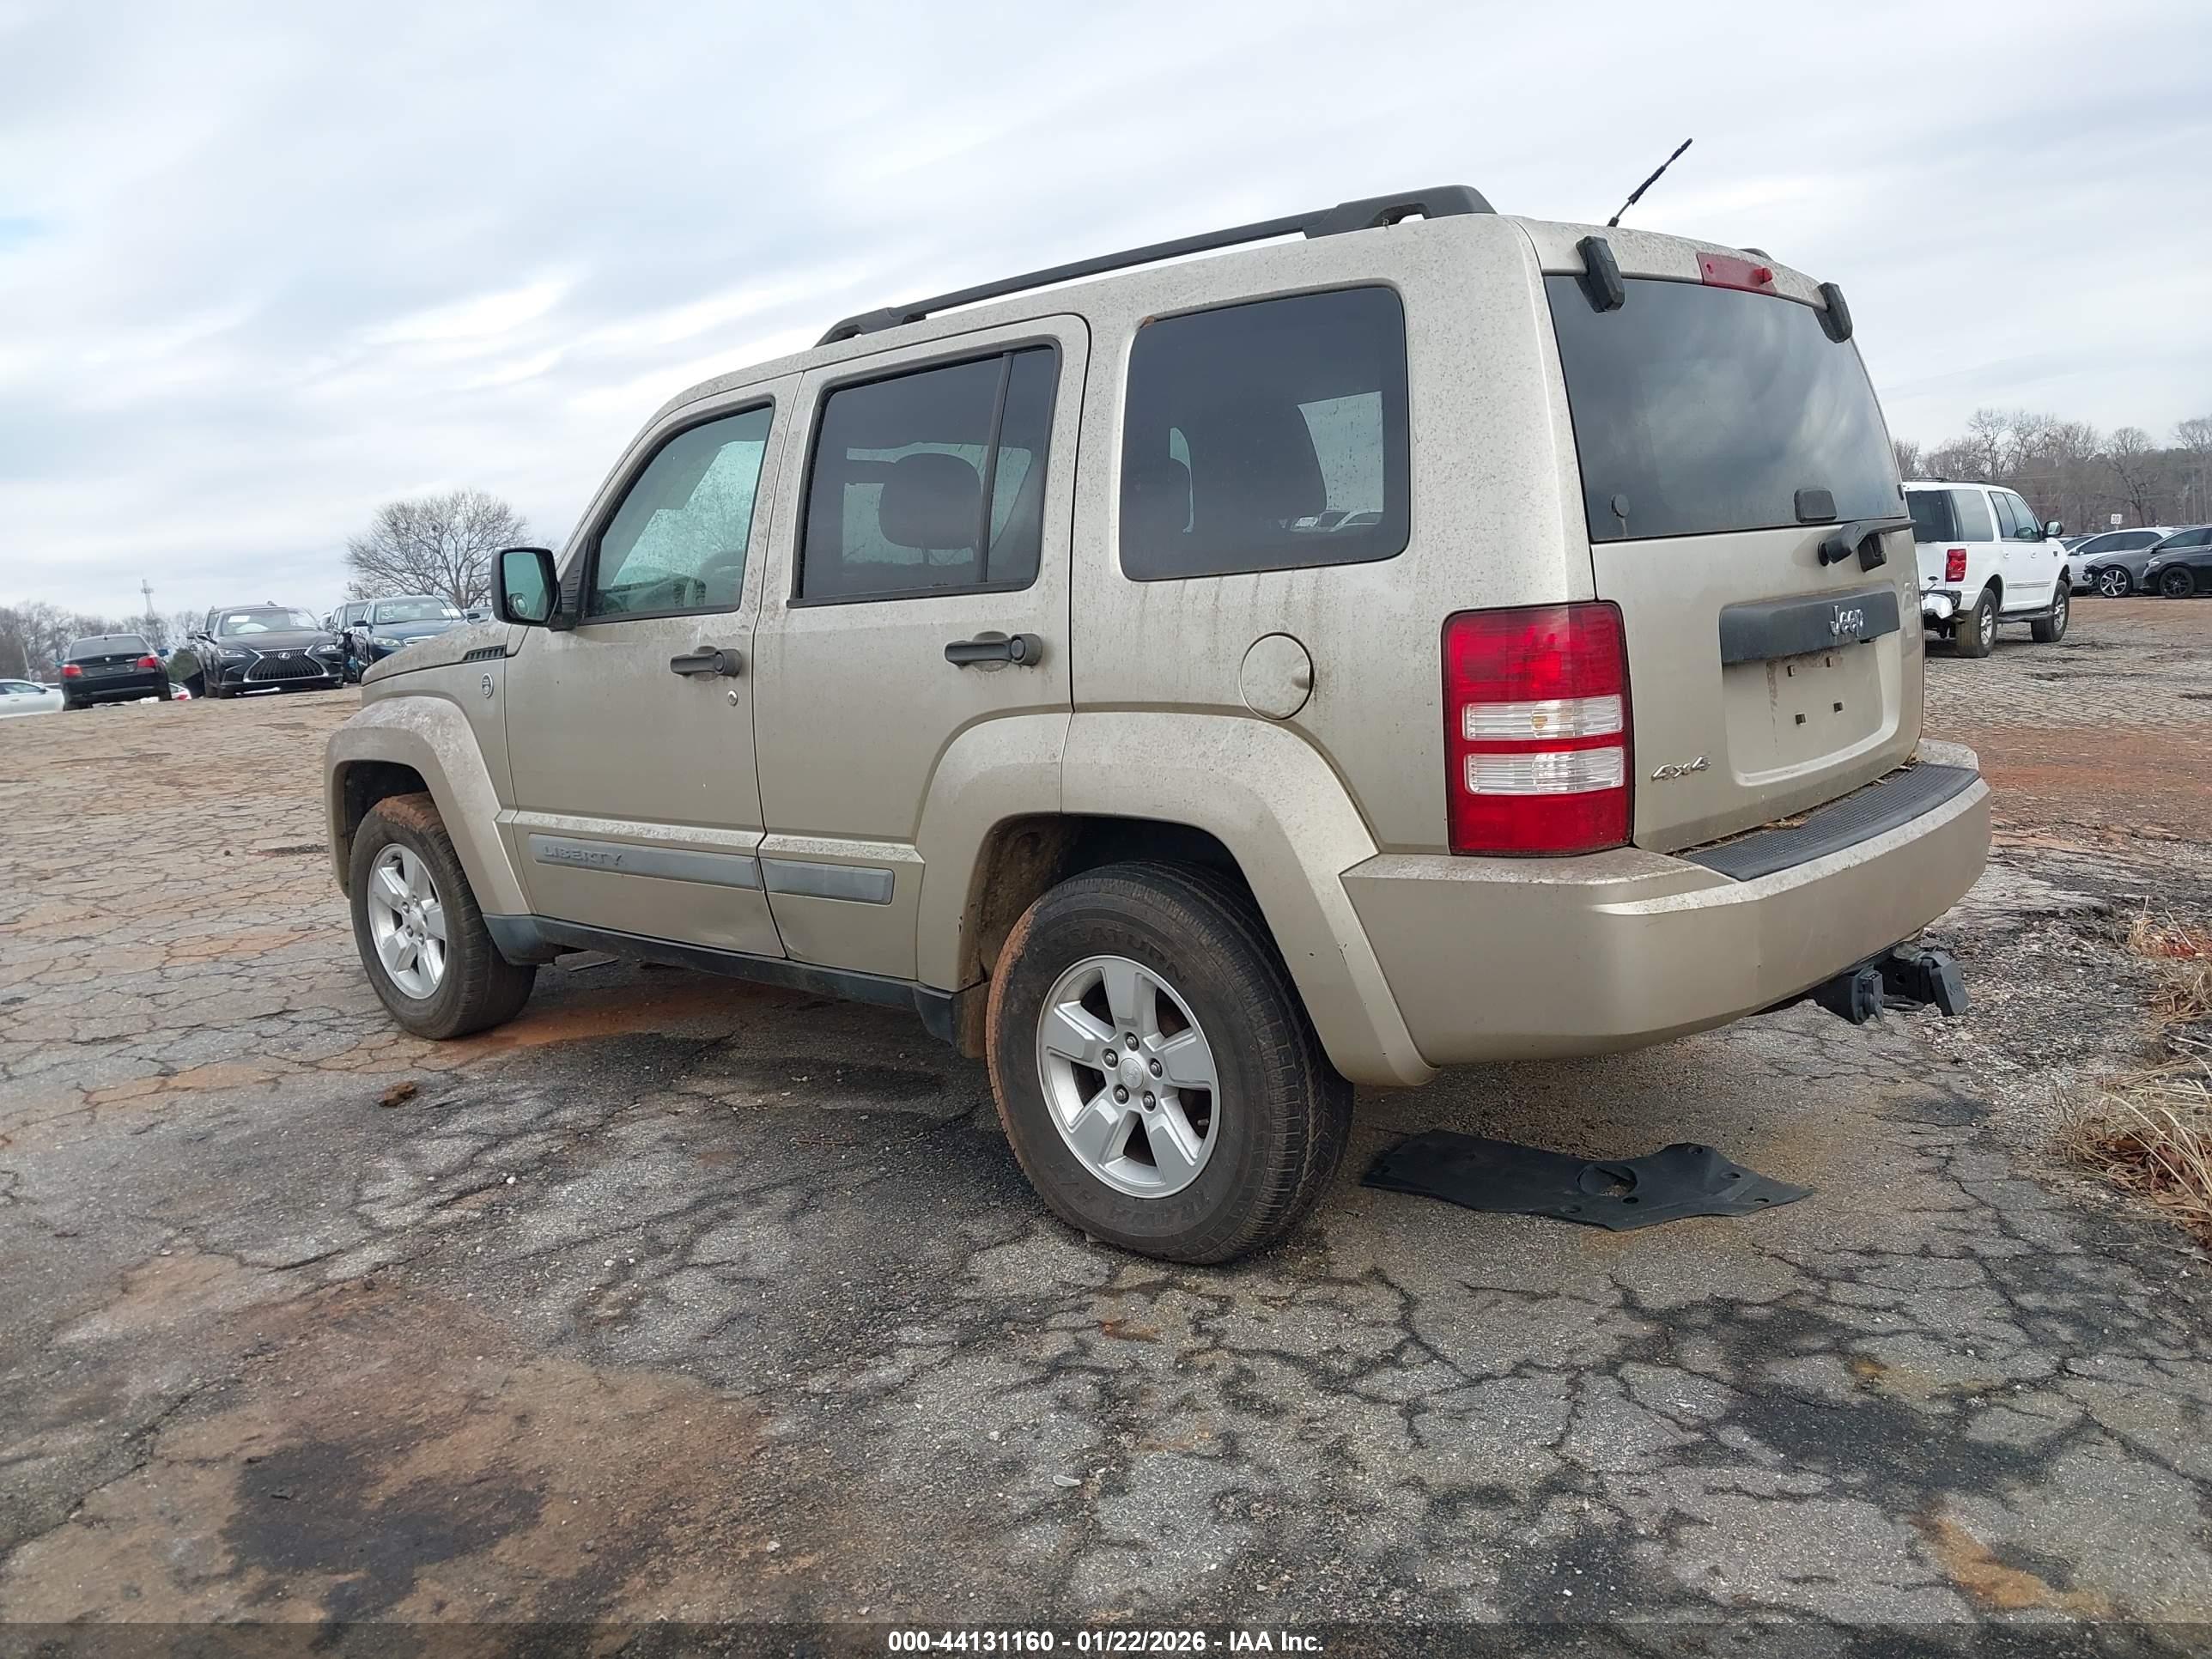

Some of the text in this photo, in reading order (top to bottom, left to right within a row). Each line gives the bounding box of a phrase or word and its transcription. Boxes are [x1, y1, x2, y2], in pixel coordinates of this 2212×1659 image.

[1829, 605, 1863, 638] Jeep
[1651, 756, 1711, 781] 4x4
[543, 844, 623, 866] LIBERTY
